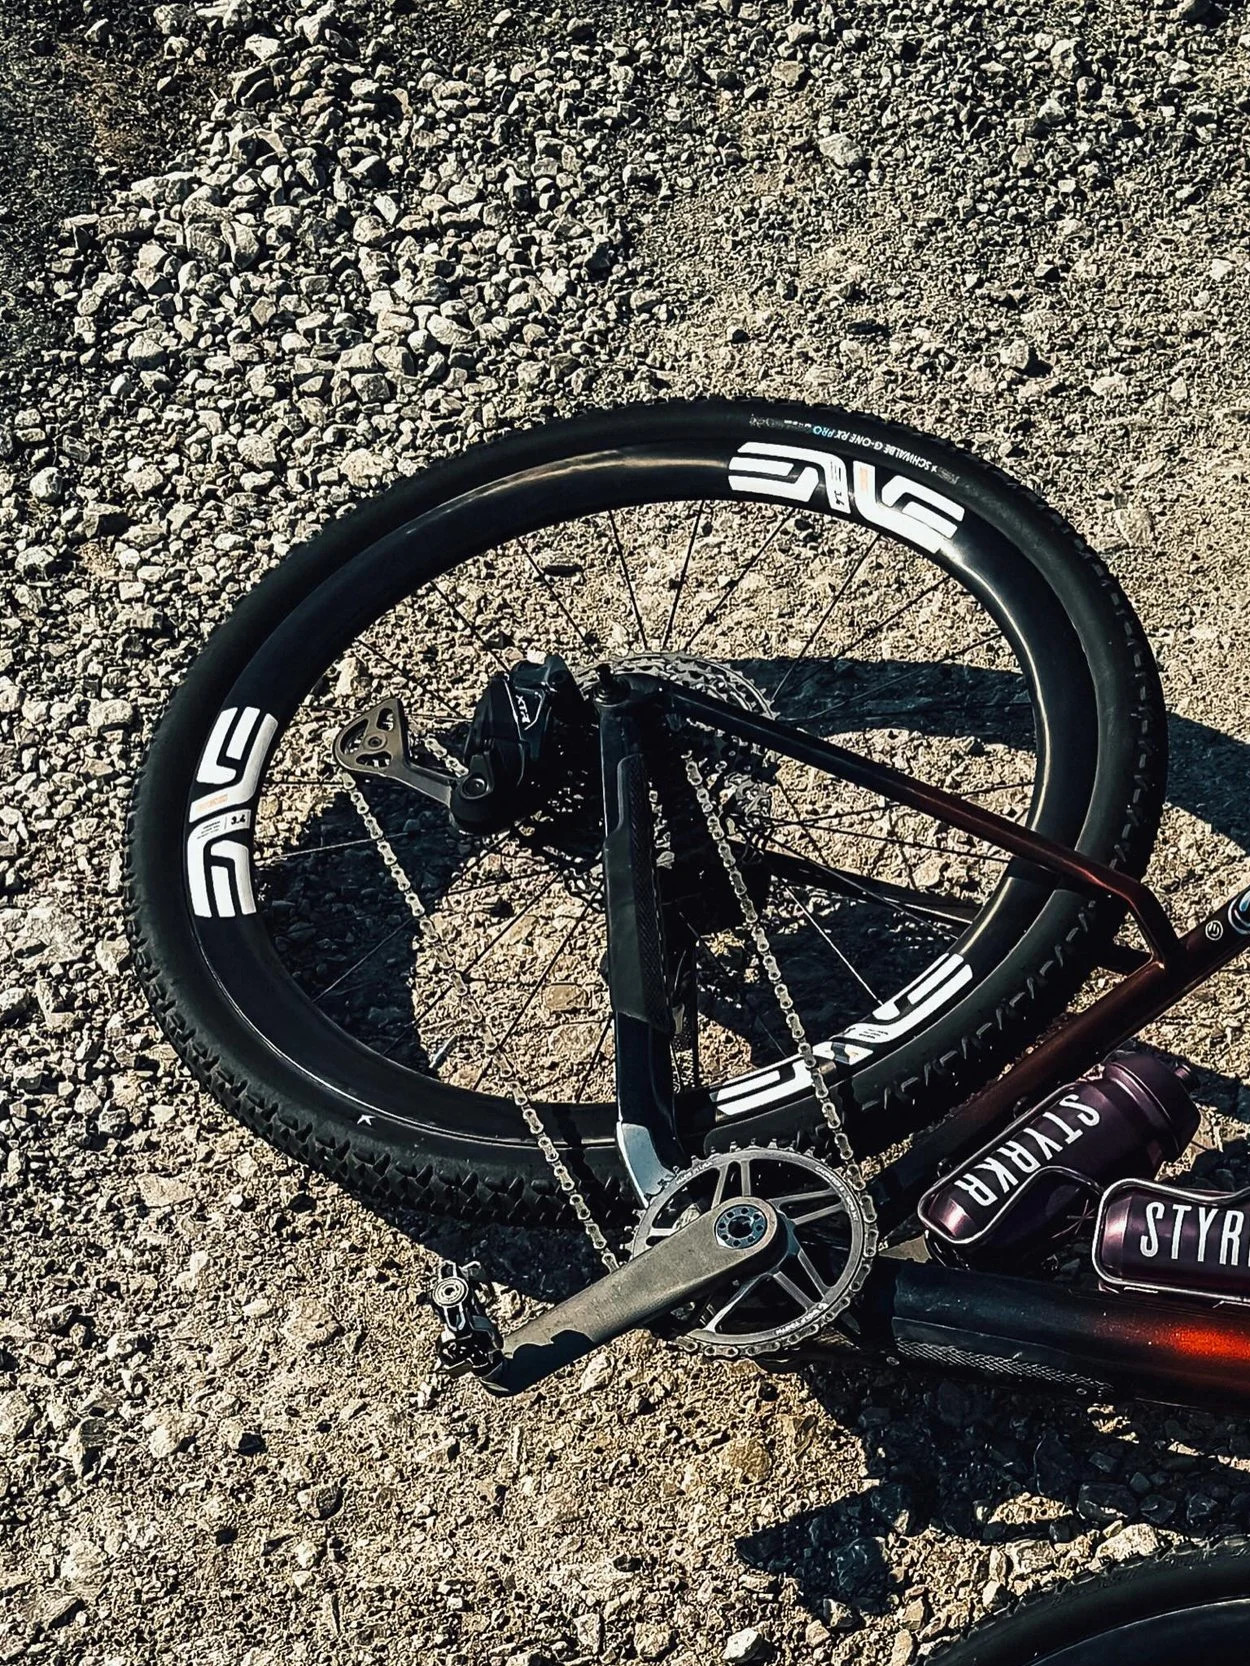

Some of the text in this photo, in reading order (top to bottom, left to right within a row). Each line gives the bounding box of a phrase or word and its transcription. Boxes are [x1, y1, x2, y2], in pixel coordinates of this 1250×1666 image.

[812, 425, 933, 471] SCHWALBE G-ONE RX PRO
[515, 694, 531, 723] XTR
[954, 1093, 1101, 1207] STYRKR
